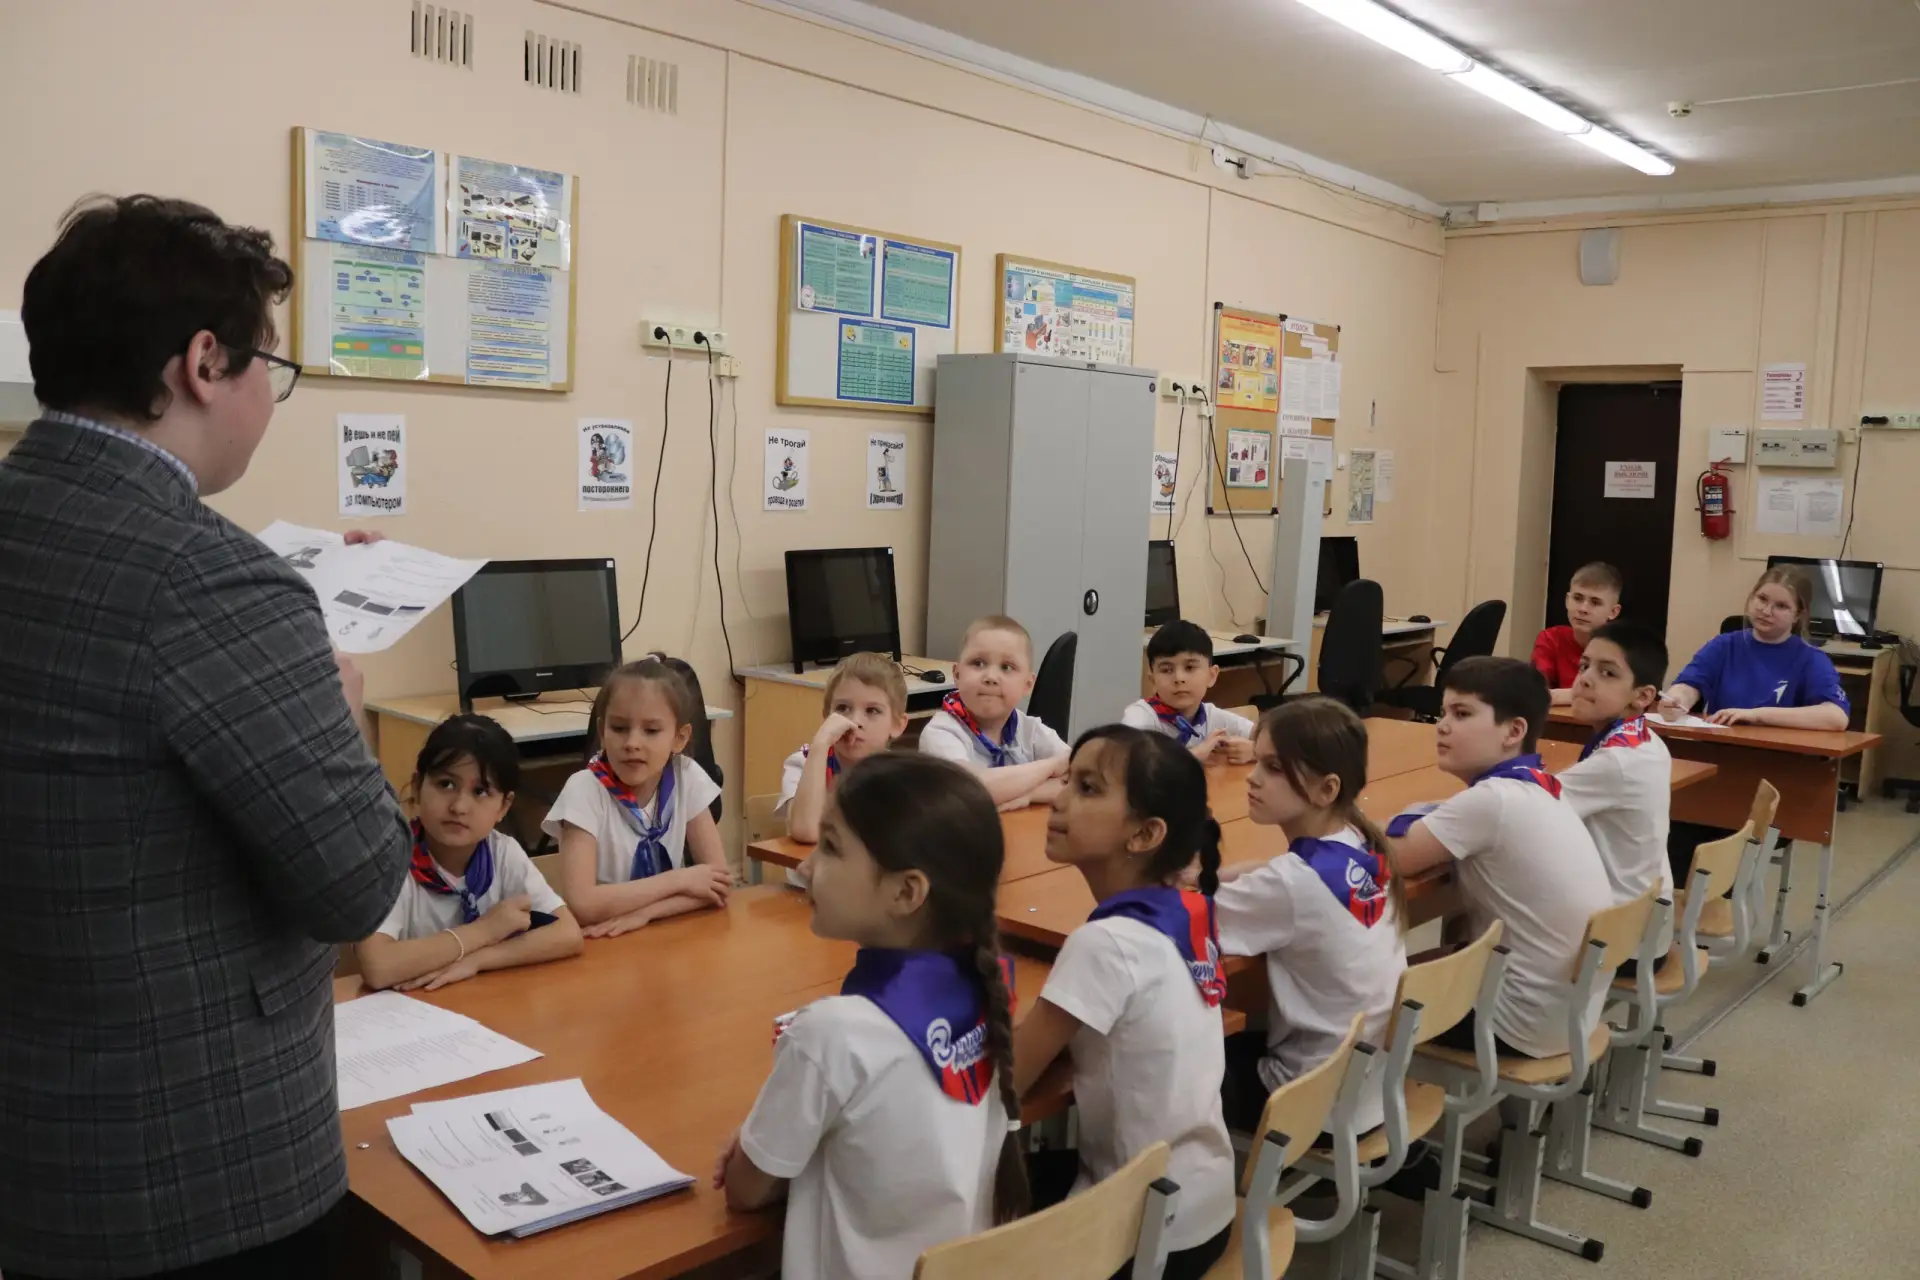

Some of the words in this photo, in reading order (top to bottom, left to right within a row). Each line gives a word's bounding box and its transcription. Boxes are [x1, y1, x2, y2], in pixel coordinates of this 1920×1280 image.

[343, 424, 353, 443] Не
[354, 430, 370, 441] ешь
[371, 431, 376, 440] и
[377, 430, 387, 440] не
[387, 425, 401, 444] пей
[768, 436, 779, 445] Не
[780, 437, 806, 449] трогай
[582, 485, 630, 494] постороннего
[344, 494, 353, 507] за
[354, 493, 402, 512] компьютером
